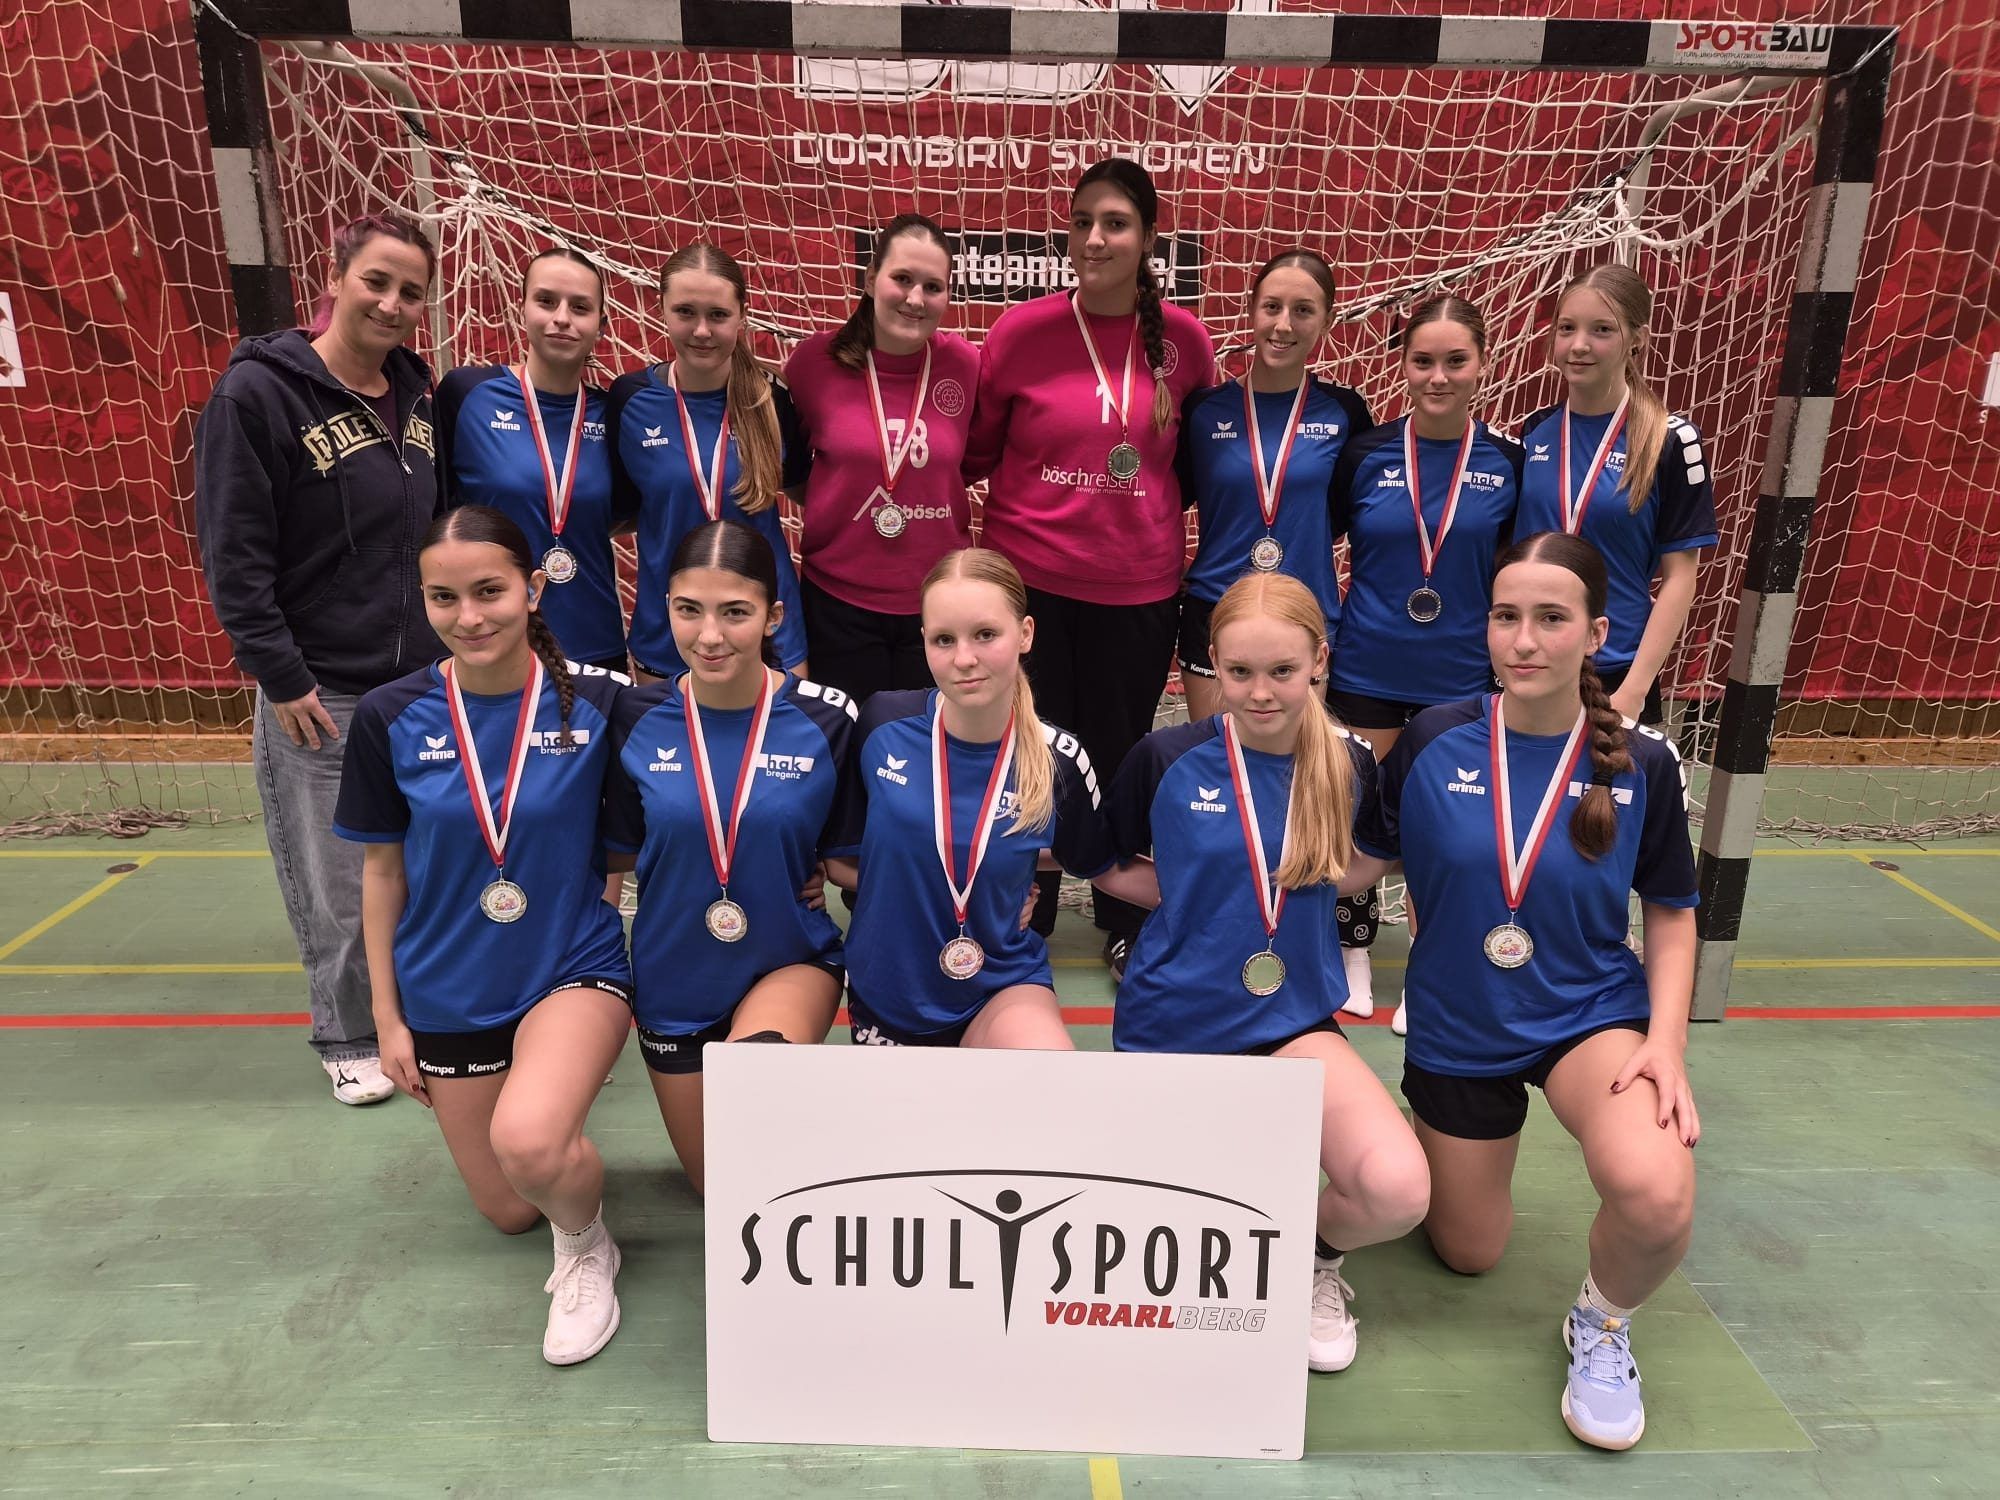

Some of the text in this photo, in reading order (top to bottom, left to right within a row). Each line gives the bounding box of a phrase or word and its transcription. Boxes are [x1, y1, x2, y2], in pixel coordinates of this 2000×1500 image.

[793, 131, 1031, 169] DORNBIRN
[490, 420, 521, 431] erima
[1211, 431, 1238, 440] erima
[642, 437, 669, 448] erima
[886, 418, 929, 469] 78
[1041, 464, 1139, 489] böschreisen
[1378, 479, 1405, 487] erima
[1190, 663, 1216, 676] Kempa
[419, 750, 456, 761] erima
[540, 745, 577, 756] bregenz
[649, 761, 682, 772] erima
[766, 769, 801, 780] bregenz
[876, 766, 908, 786] erima
[1447, 782, 1485, 796] erima
[1190, 800, 1226, 813] erima
[419, 1059, 506, 1076] Kempa Kempa
[739, 1212, 1281, 1301] SCHUL SPORT
[1044, 1300, 1267, 1333] VORARLBERG
